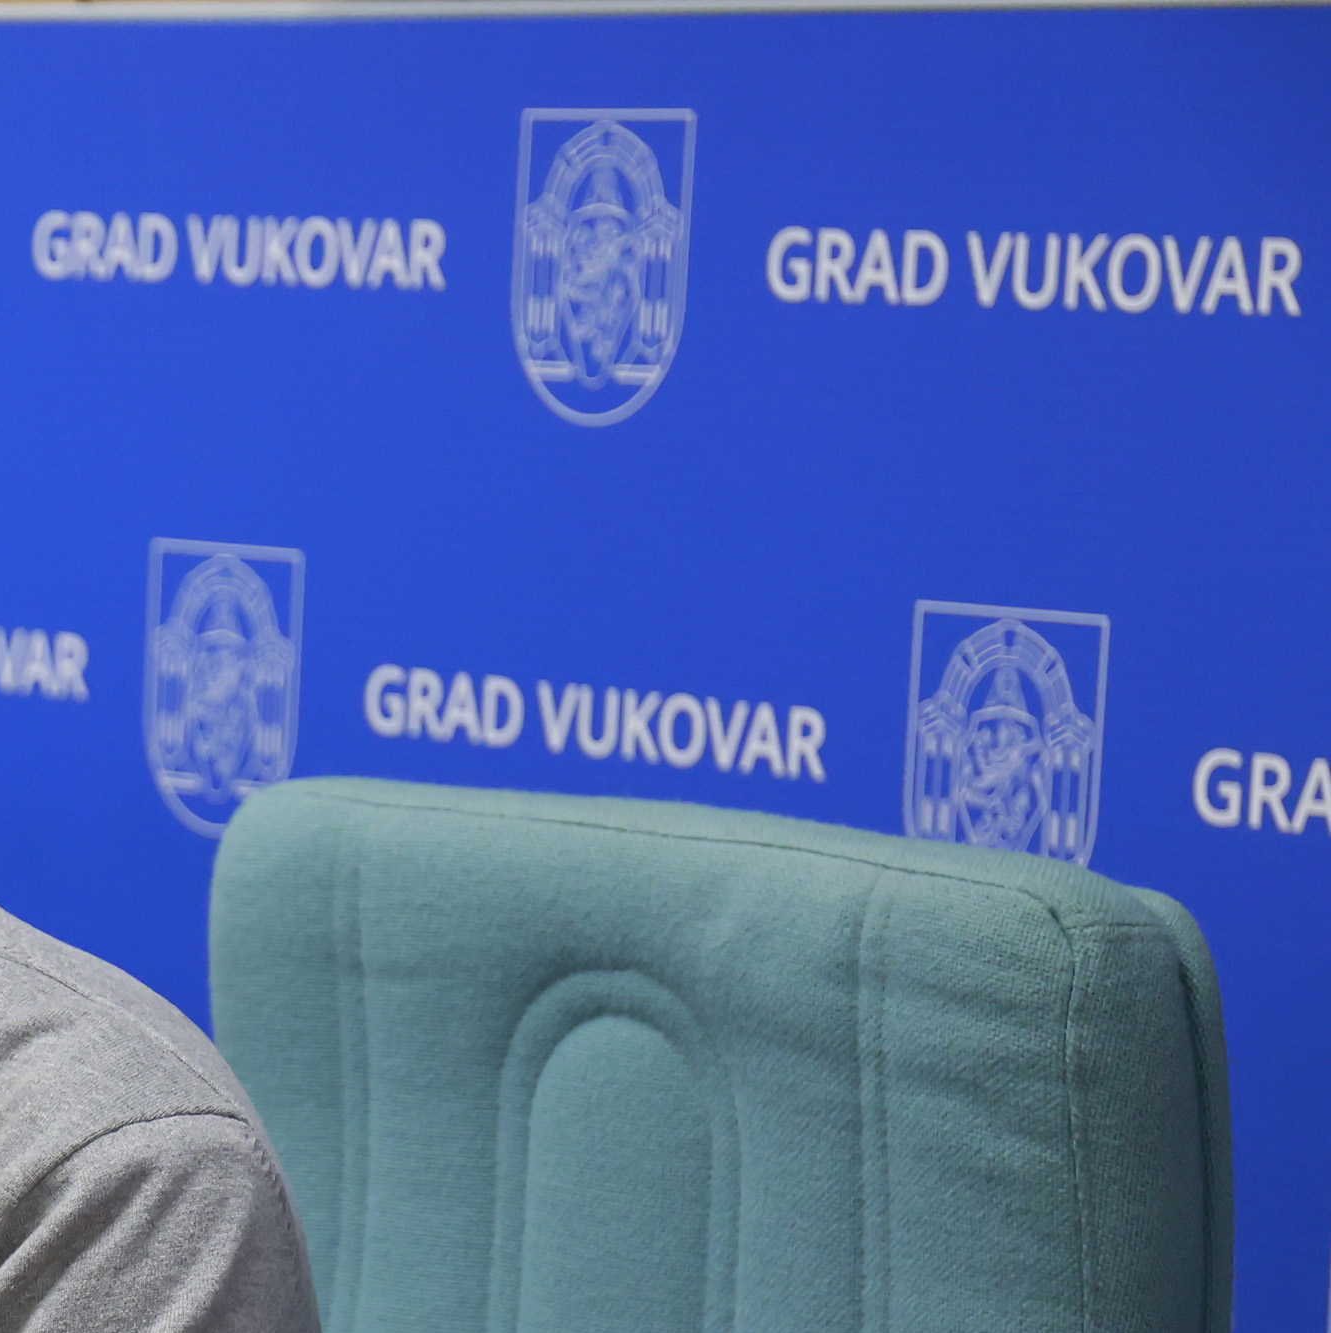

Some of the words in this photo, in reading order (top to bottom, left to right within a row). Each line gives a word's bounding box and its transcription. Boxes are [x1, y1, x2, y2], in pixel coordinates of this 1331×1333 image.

[31, 210, 178, 283] GRAD
[186, 214, 446, 291] VUKOVAR
[766, 225, 948, 306] GRAD
[966, 230, 1302, 317] VUKOVAR
[363, 663, 525, 748] GRAD
[535, 680, 826, 782] VUKOVAR
[1192, 746, 1331, 837] GRA
